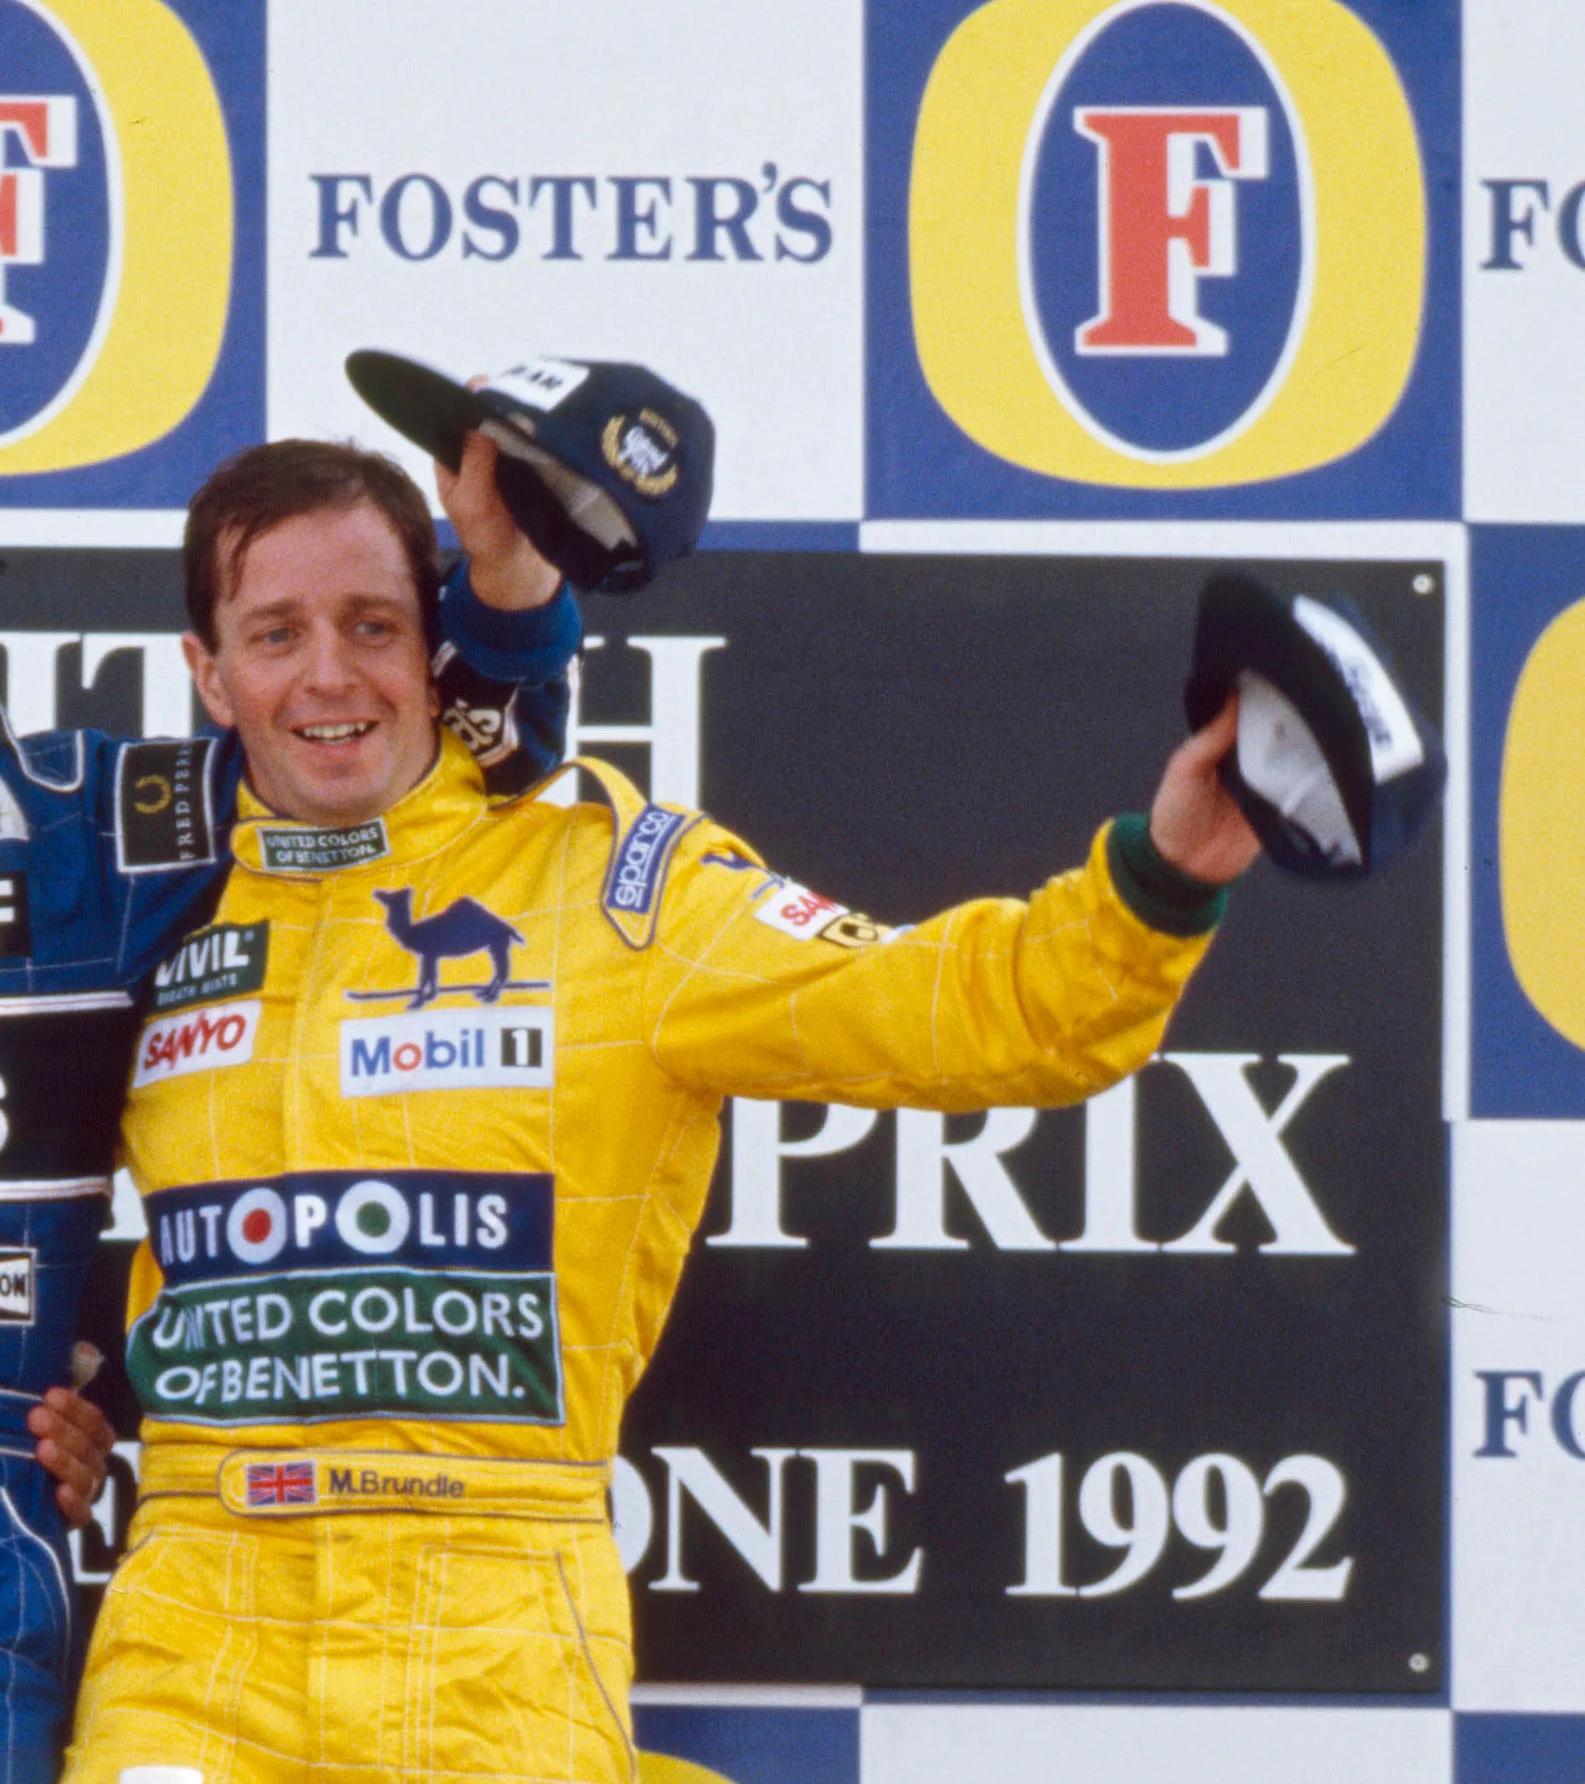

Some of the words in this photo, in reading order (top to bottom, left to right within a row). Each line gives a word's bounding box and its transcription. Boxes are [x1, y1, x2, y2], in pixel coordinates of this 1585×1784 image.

[309, 160, 833, 263] FOSTER'S
[266, 834, 314, 849] UNITED
[317, 826, 379, 848] COLORS
[613, 808, 680, 908] sparco
[144, 1013, 247, 1070] SANYO
[351, 1028, 484, 1078] Mobil
[706, 1053, 1356, 1256] PRIX
[160, 1179, 508, 1265] AUTOPOLIS
[152, 1294, 292, 1353] UNITED
[309, 1288, 545, 1338] COLORS
[1006, 1451, 1356, 1602] 1992
